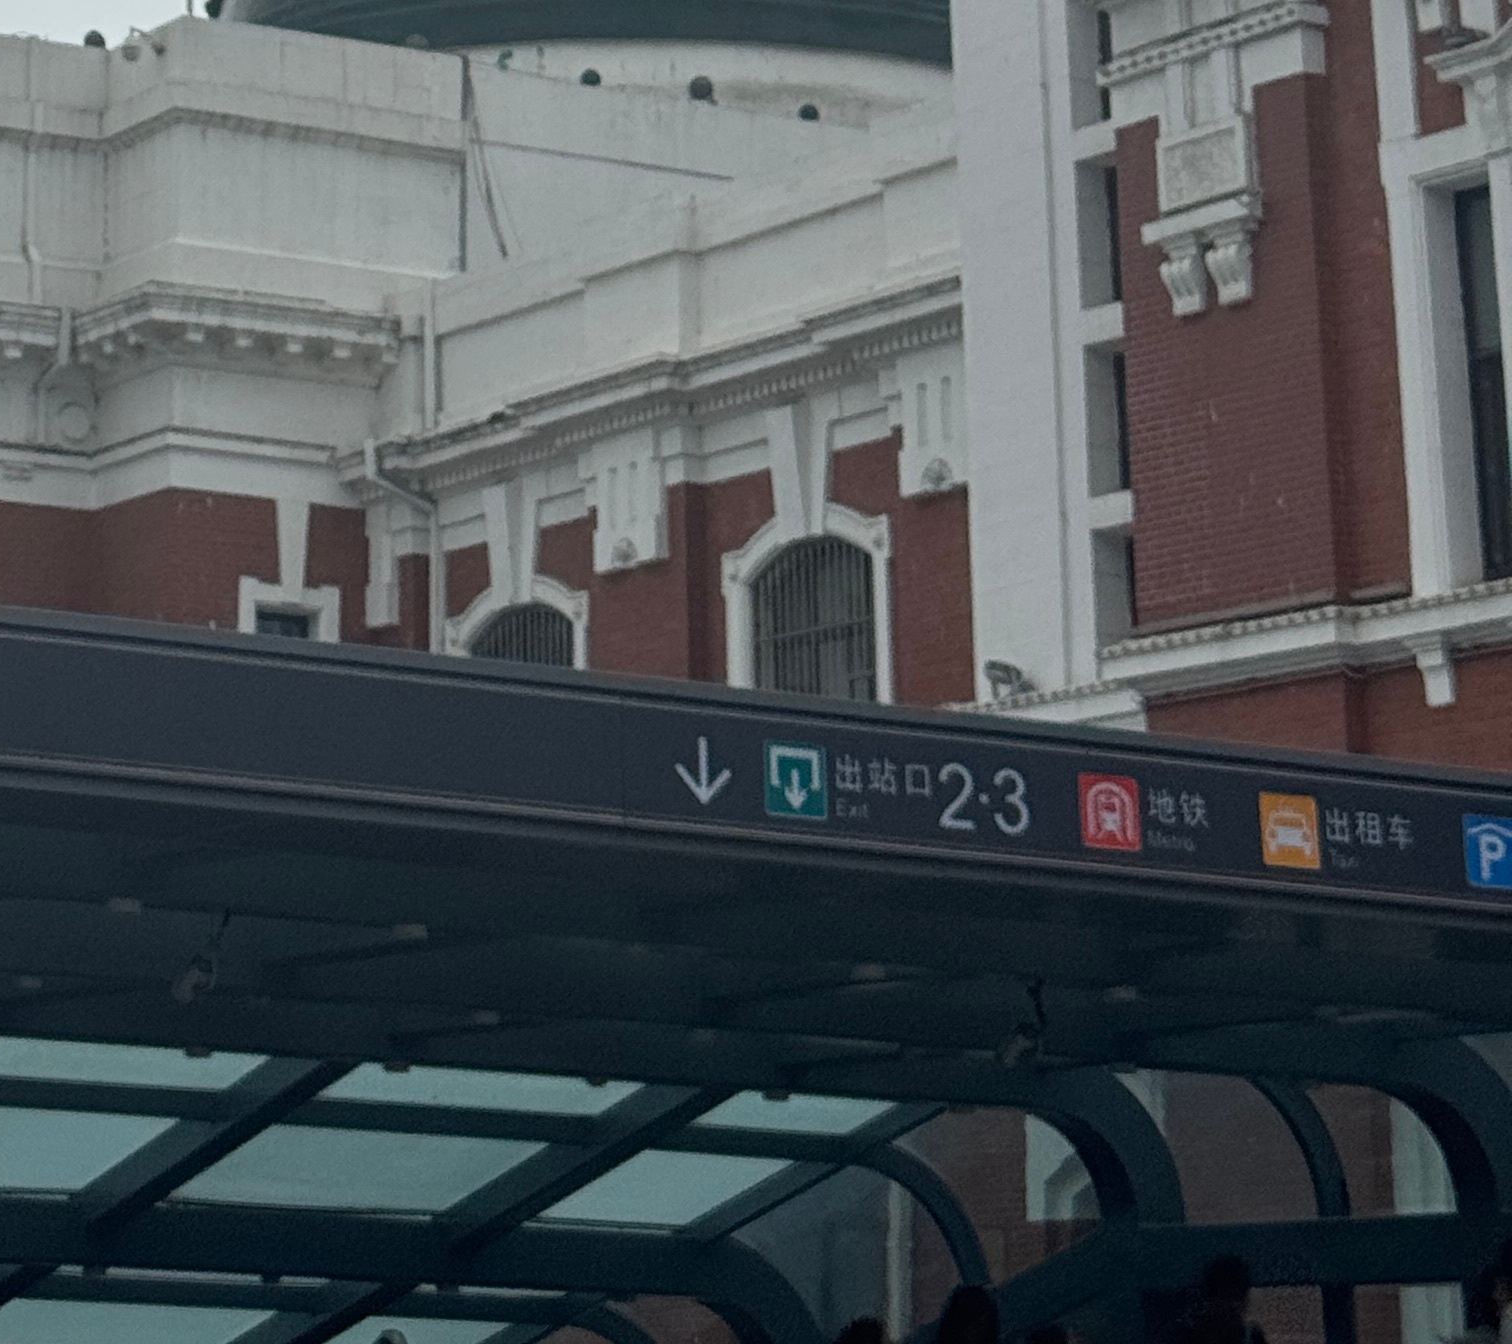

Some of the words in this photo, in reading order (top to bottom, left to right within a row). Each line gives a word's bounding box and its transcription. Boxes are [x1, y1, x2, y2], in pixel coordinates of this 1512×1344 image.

[835, 753, 934, 797] 出站口
[835, 797, 870, 819] Exit
[1147, 787, 1209, 828] 地铁
[1324, 807, 1415, 851] 出租车
